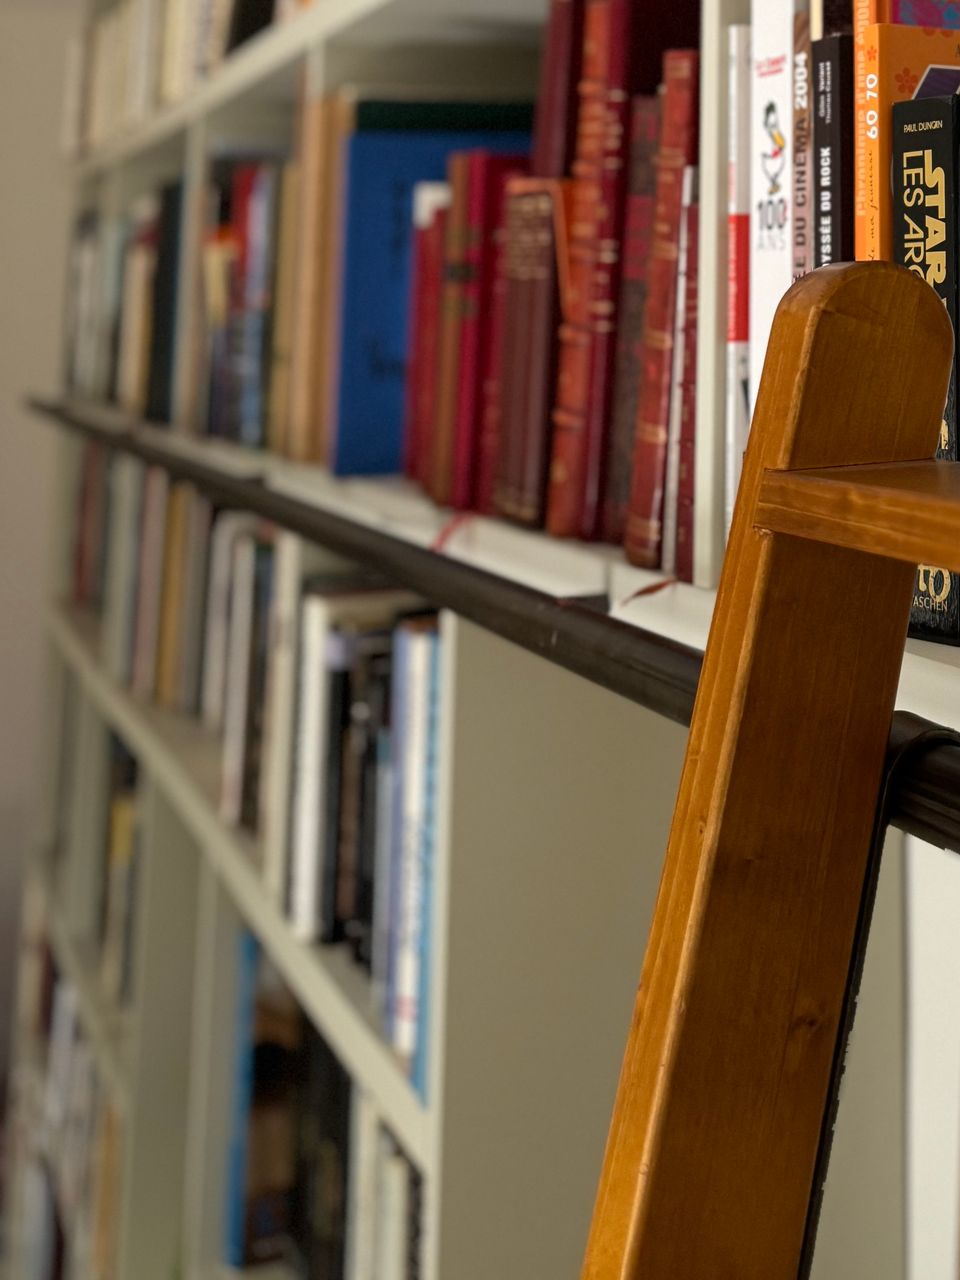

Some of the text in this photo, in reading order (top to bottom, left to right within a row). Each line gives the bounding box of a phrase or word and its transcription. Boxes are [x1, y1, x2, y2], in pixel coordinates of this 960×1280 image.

[794, 51, 808, 110] 2004
[866, 73, 879, 140] 60 70
[903, 123, 918, 133] PAUL
[819, 146, 832, 266] YSSÉE DU ROCK
[903, 150, 924, 207] LES
[795, 217, 806, 247] DU
[924, 149, 947, 288] STAR
[912, 596, 948, 613] ASCHEN
